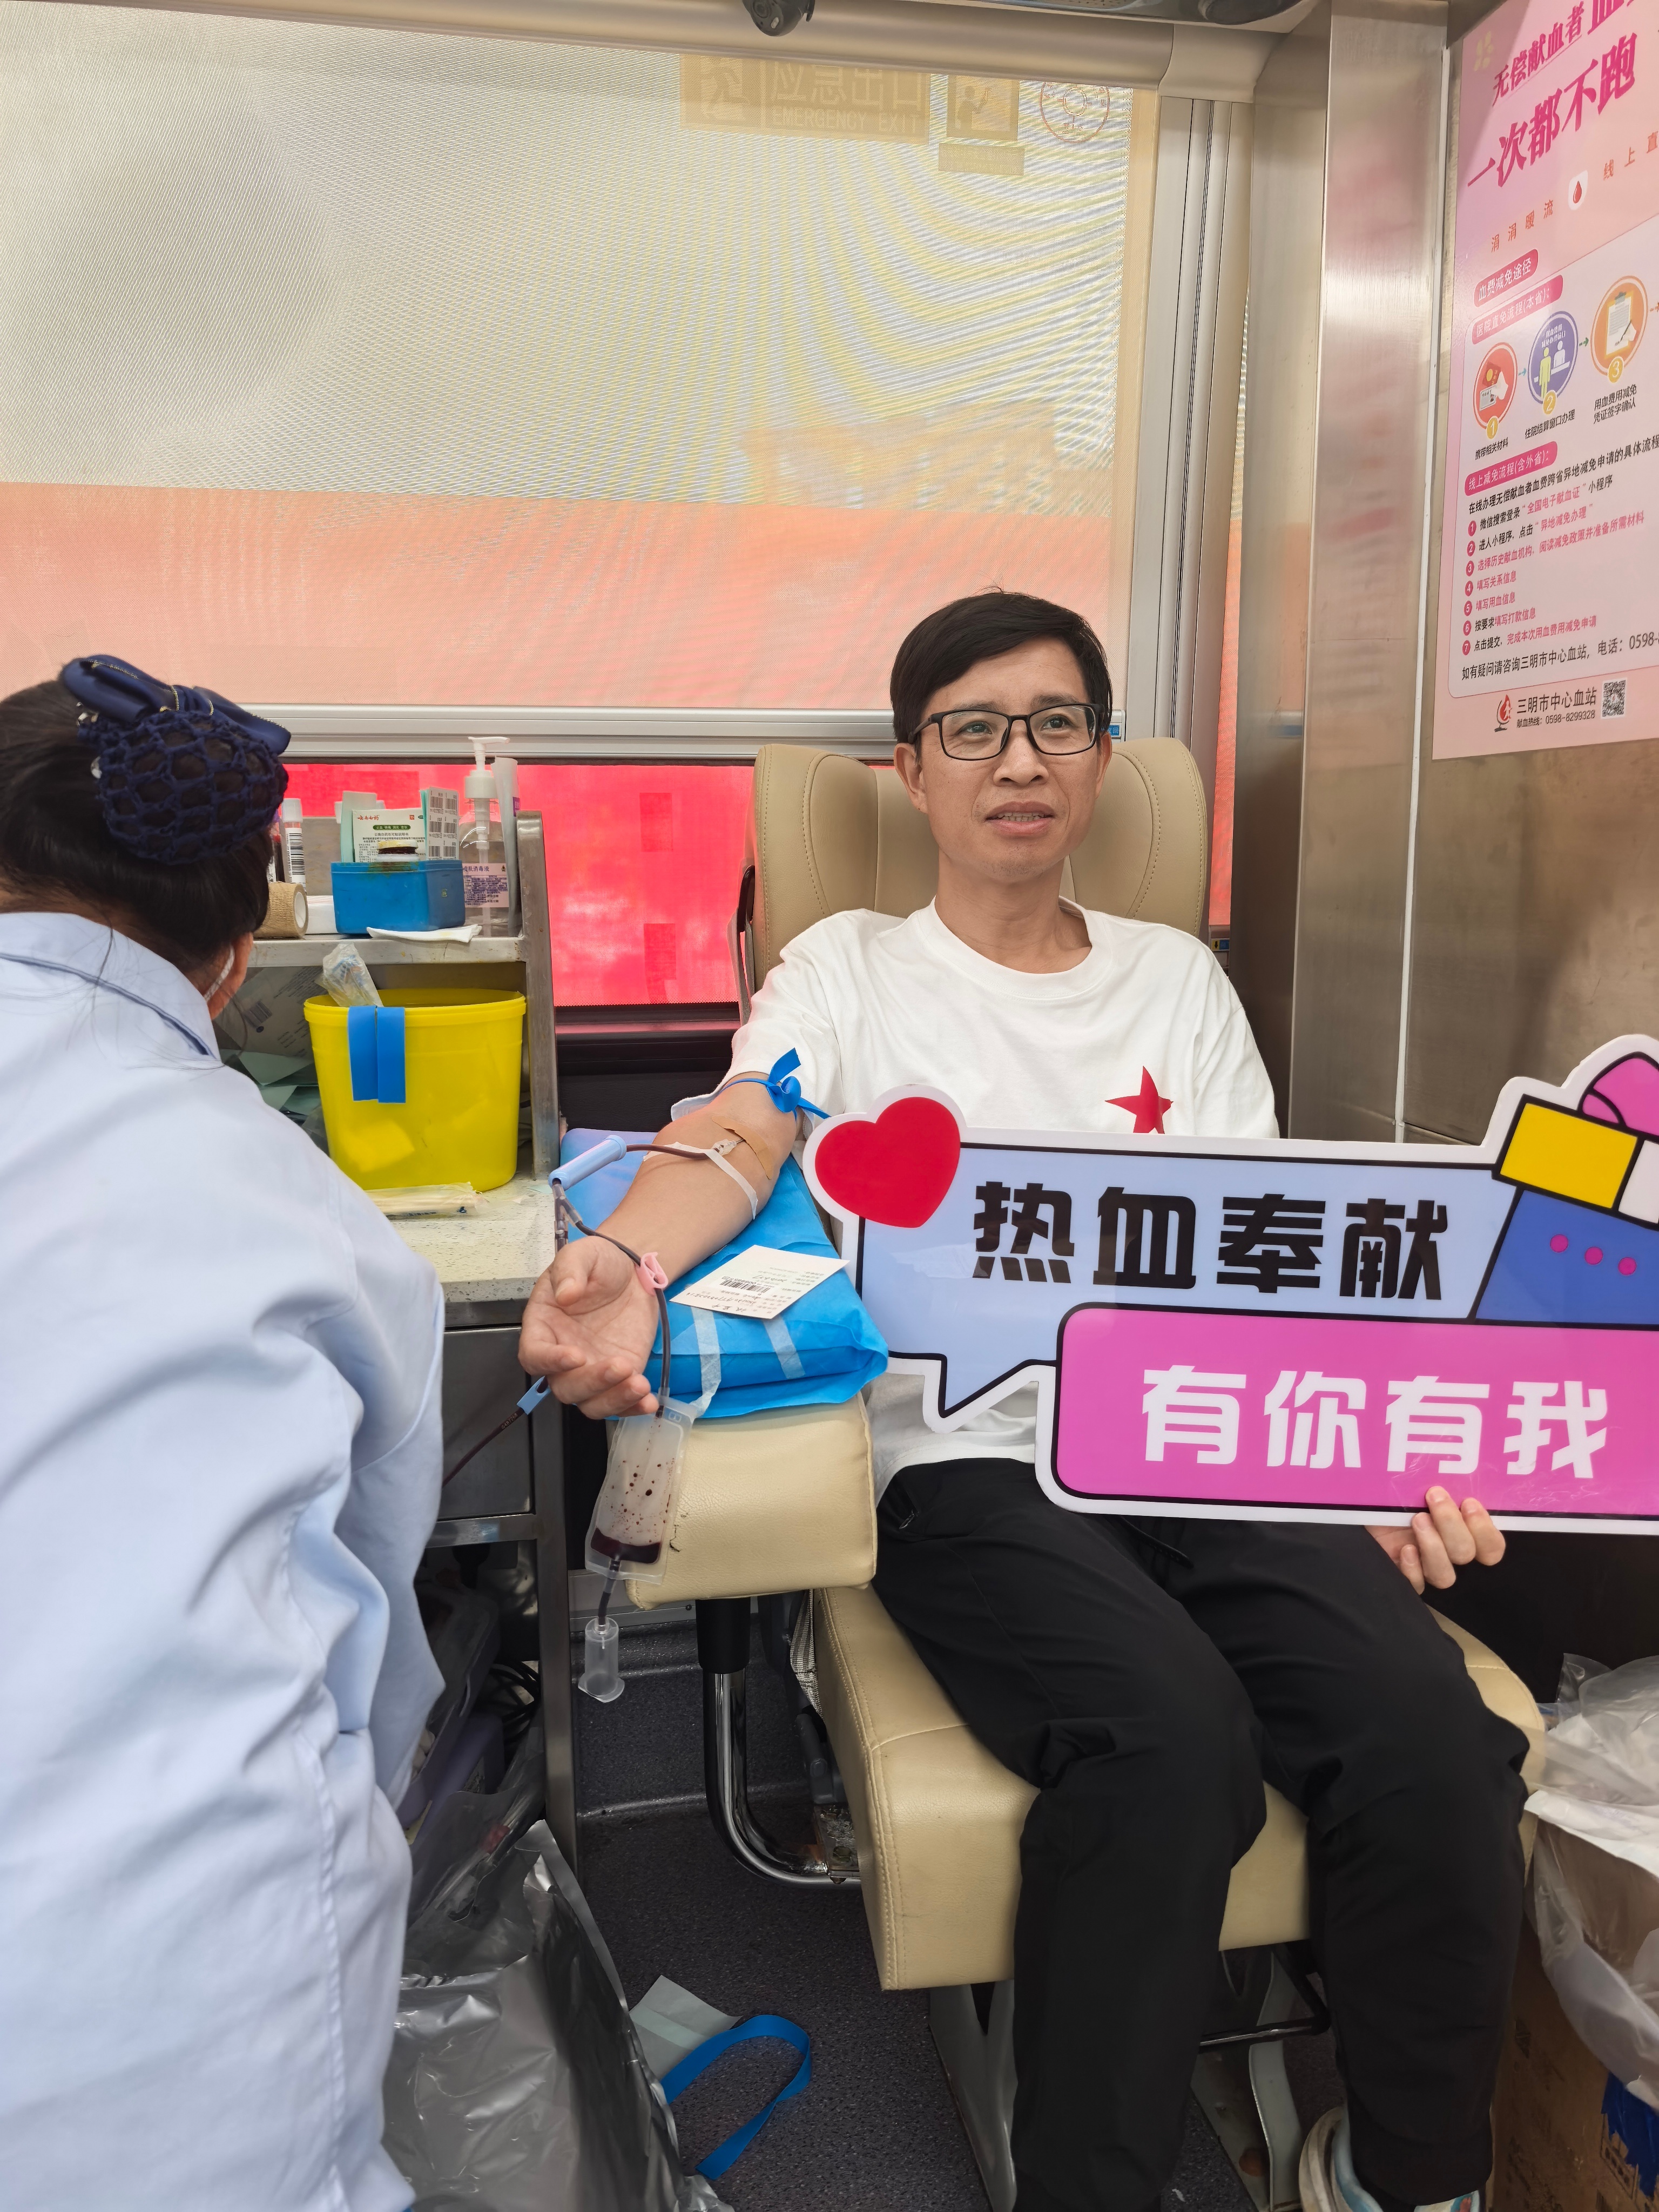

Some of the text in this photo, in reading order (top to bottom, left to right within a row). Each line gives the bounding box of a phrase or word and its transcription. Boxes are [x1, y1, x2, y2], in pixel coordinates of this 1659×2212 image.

[1493, 1, 1584, 106] 无偿献血者
[771, 106, 918, 133] EMERGENCY EXIT
[1468, 32, 1637, 187] 一次都不跑
[1492, 199, 1554, 253] 涓涓暖流
[1479, 257, 1532, 301] 血费减免途径
[1611, 361, 1620, 378] 3
[1546, 396, 1553, 412] 2
[1594, 384, 1637, 411] 用血费用减免
[1594, 396, 1636, 424] 凭证签字确认
[1525, 409, 1575, 439] 住院结算窗口办理
[1475, 437, 1508, 460] 携带相关材料
[1477, 570, 1516, 590] 填写关系信息
[1476, 592, 1515, 611] 填写用血信息
[1475, 607, 1536, 632] 按要求填写打款信息
[1462, 631, 1659, 680] 如有疑问请咨询三明市中心血站，电话：0598-
[1517, 686, 1597, 713] 三明市中心血站
[973, 1182, 1448, 1299] 热血奉献
[1142, 1365, 1608, 1479] 有你有我
